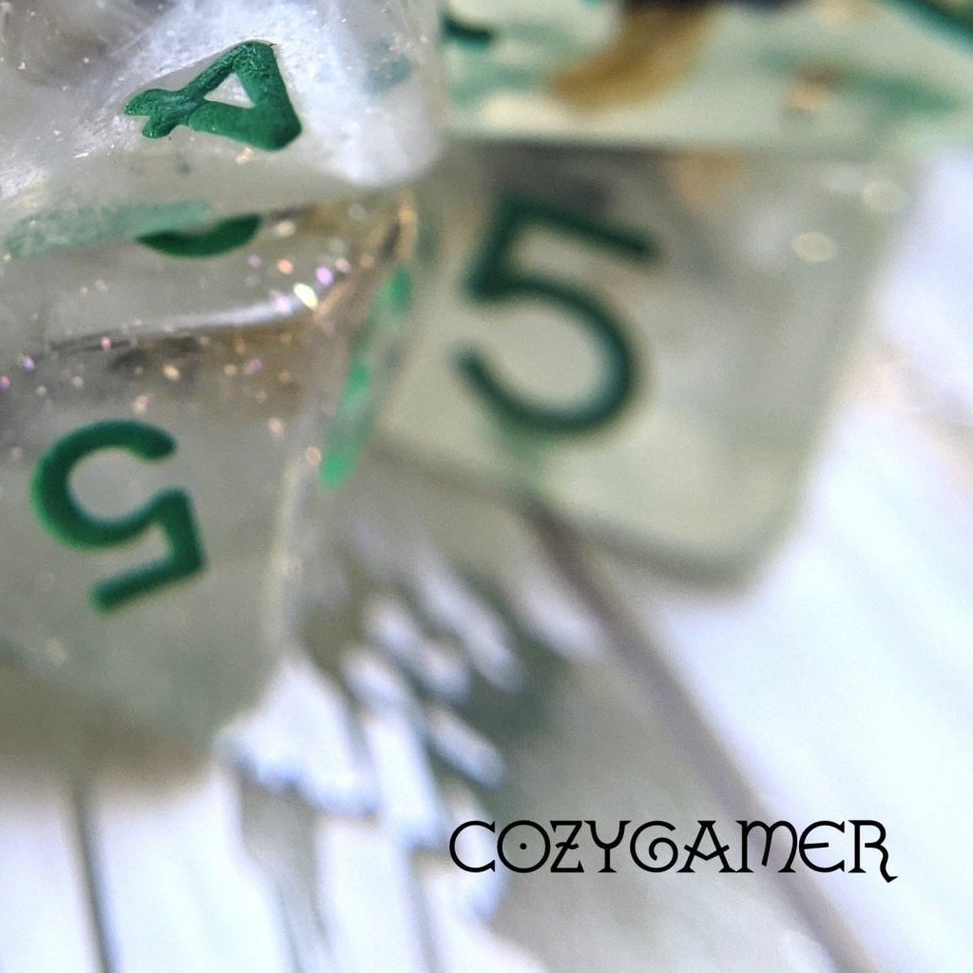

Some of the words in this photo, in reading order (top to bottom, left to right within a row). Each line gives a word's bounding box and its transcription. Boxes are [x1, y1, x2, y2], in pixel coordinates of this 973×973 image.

[125, 40, 303, 152] 4
[453, 191, 659, 439] 5
[31, 419, 207, 612] 5
